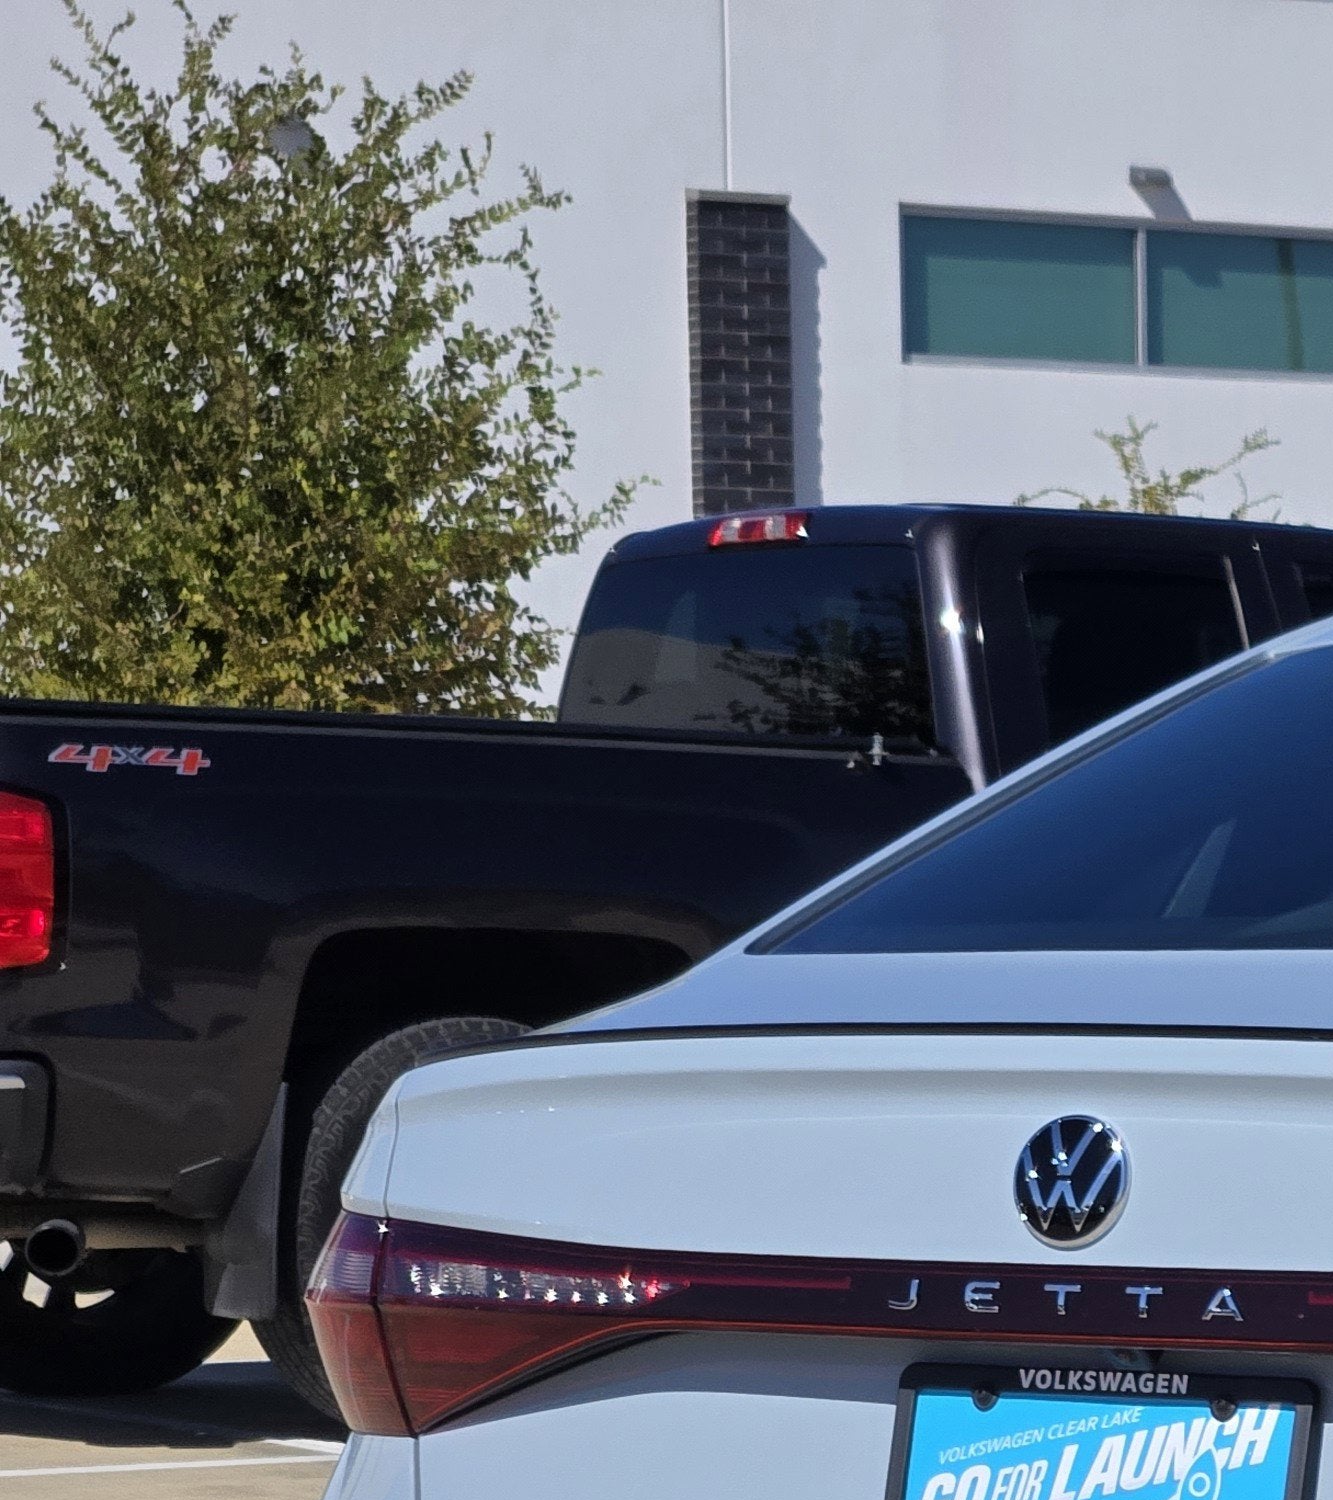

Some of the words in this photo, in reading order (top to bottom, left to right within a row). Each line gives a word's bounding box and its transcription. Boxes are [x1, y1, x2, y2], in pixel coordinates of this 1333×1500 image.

[1013, 1115, 1132, 1250] VW
[888, 1278, 1244, 1322] JETTA
[1018, 1368, 1189, 1395] VOLKSWAGEN
[938, 1429, 1045, 1465] VOLKSWAGEN
[1047, 1419, 1098, 1443] CLEAR
[1101, 1407, 1143, 1429] LAKE
